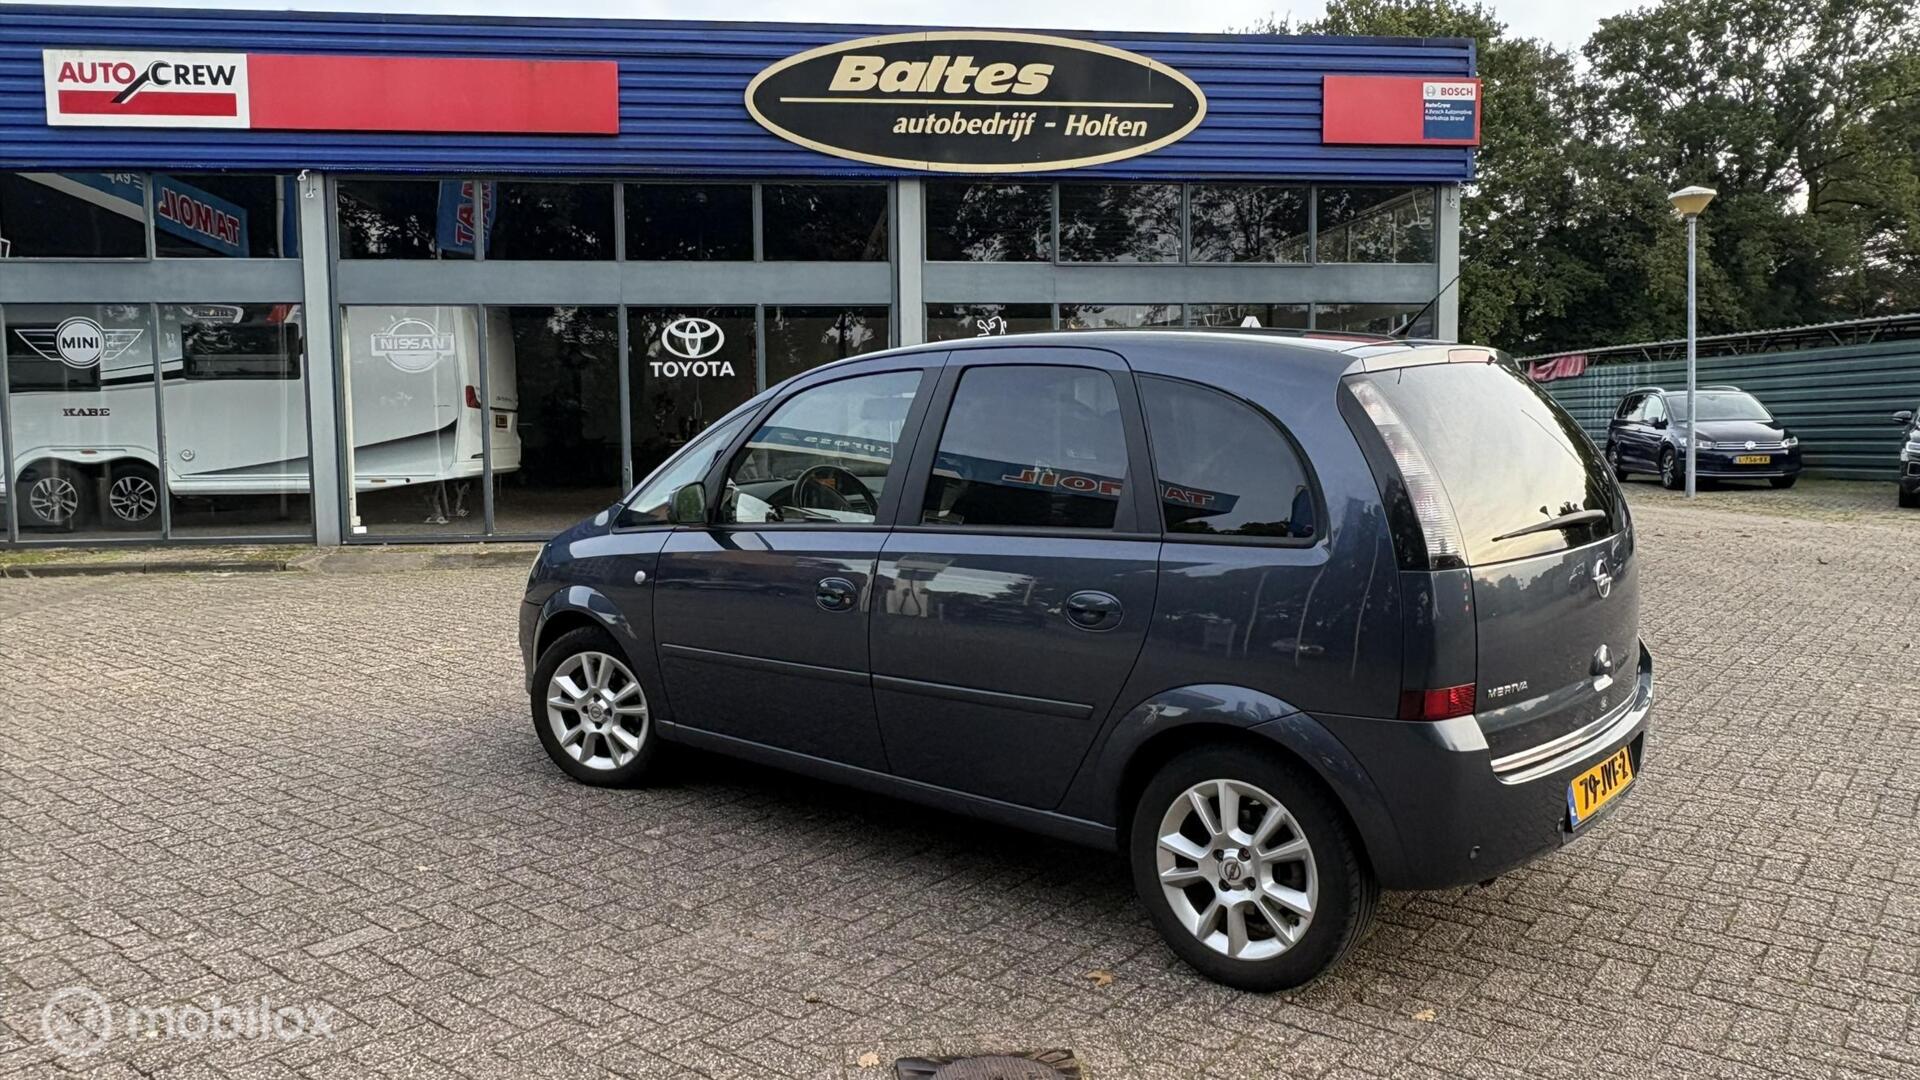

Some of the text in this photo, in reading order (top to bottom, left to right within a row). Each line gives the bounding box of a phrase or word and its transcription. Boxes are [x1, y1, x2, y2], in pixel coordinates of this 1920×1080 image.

[58, 61, 237, 86] AUTO CREW
[829, 55, 1054, 95] Baltes
[1440, 87, 1473, 96] BOSCH
[893, 111, 1037, 142] autobedrijf
[1064, 114, 1148, 137] Holten
[62, 336, 99, 349] MINI
[380, 338, 445, 350] NISSAN
[649, 360, 736, 378] TOYOTA
[63, 407, 111, 417] KABE
[1487, 680, 1528, 699] MERIVA
